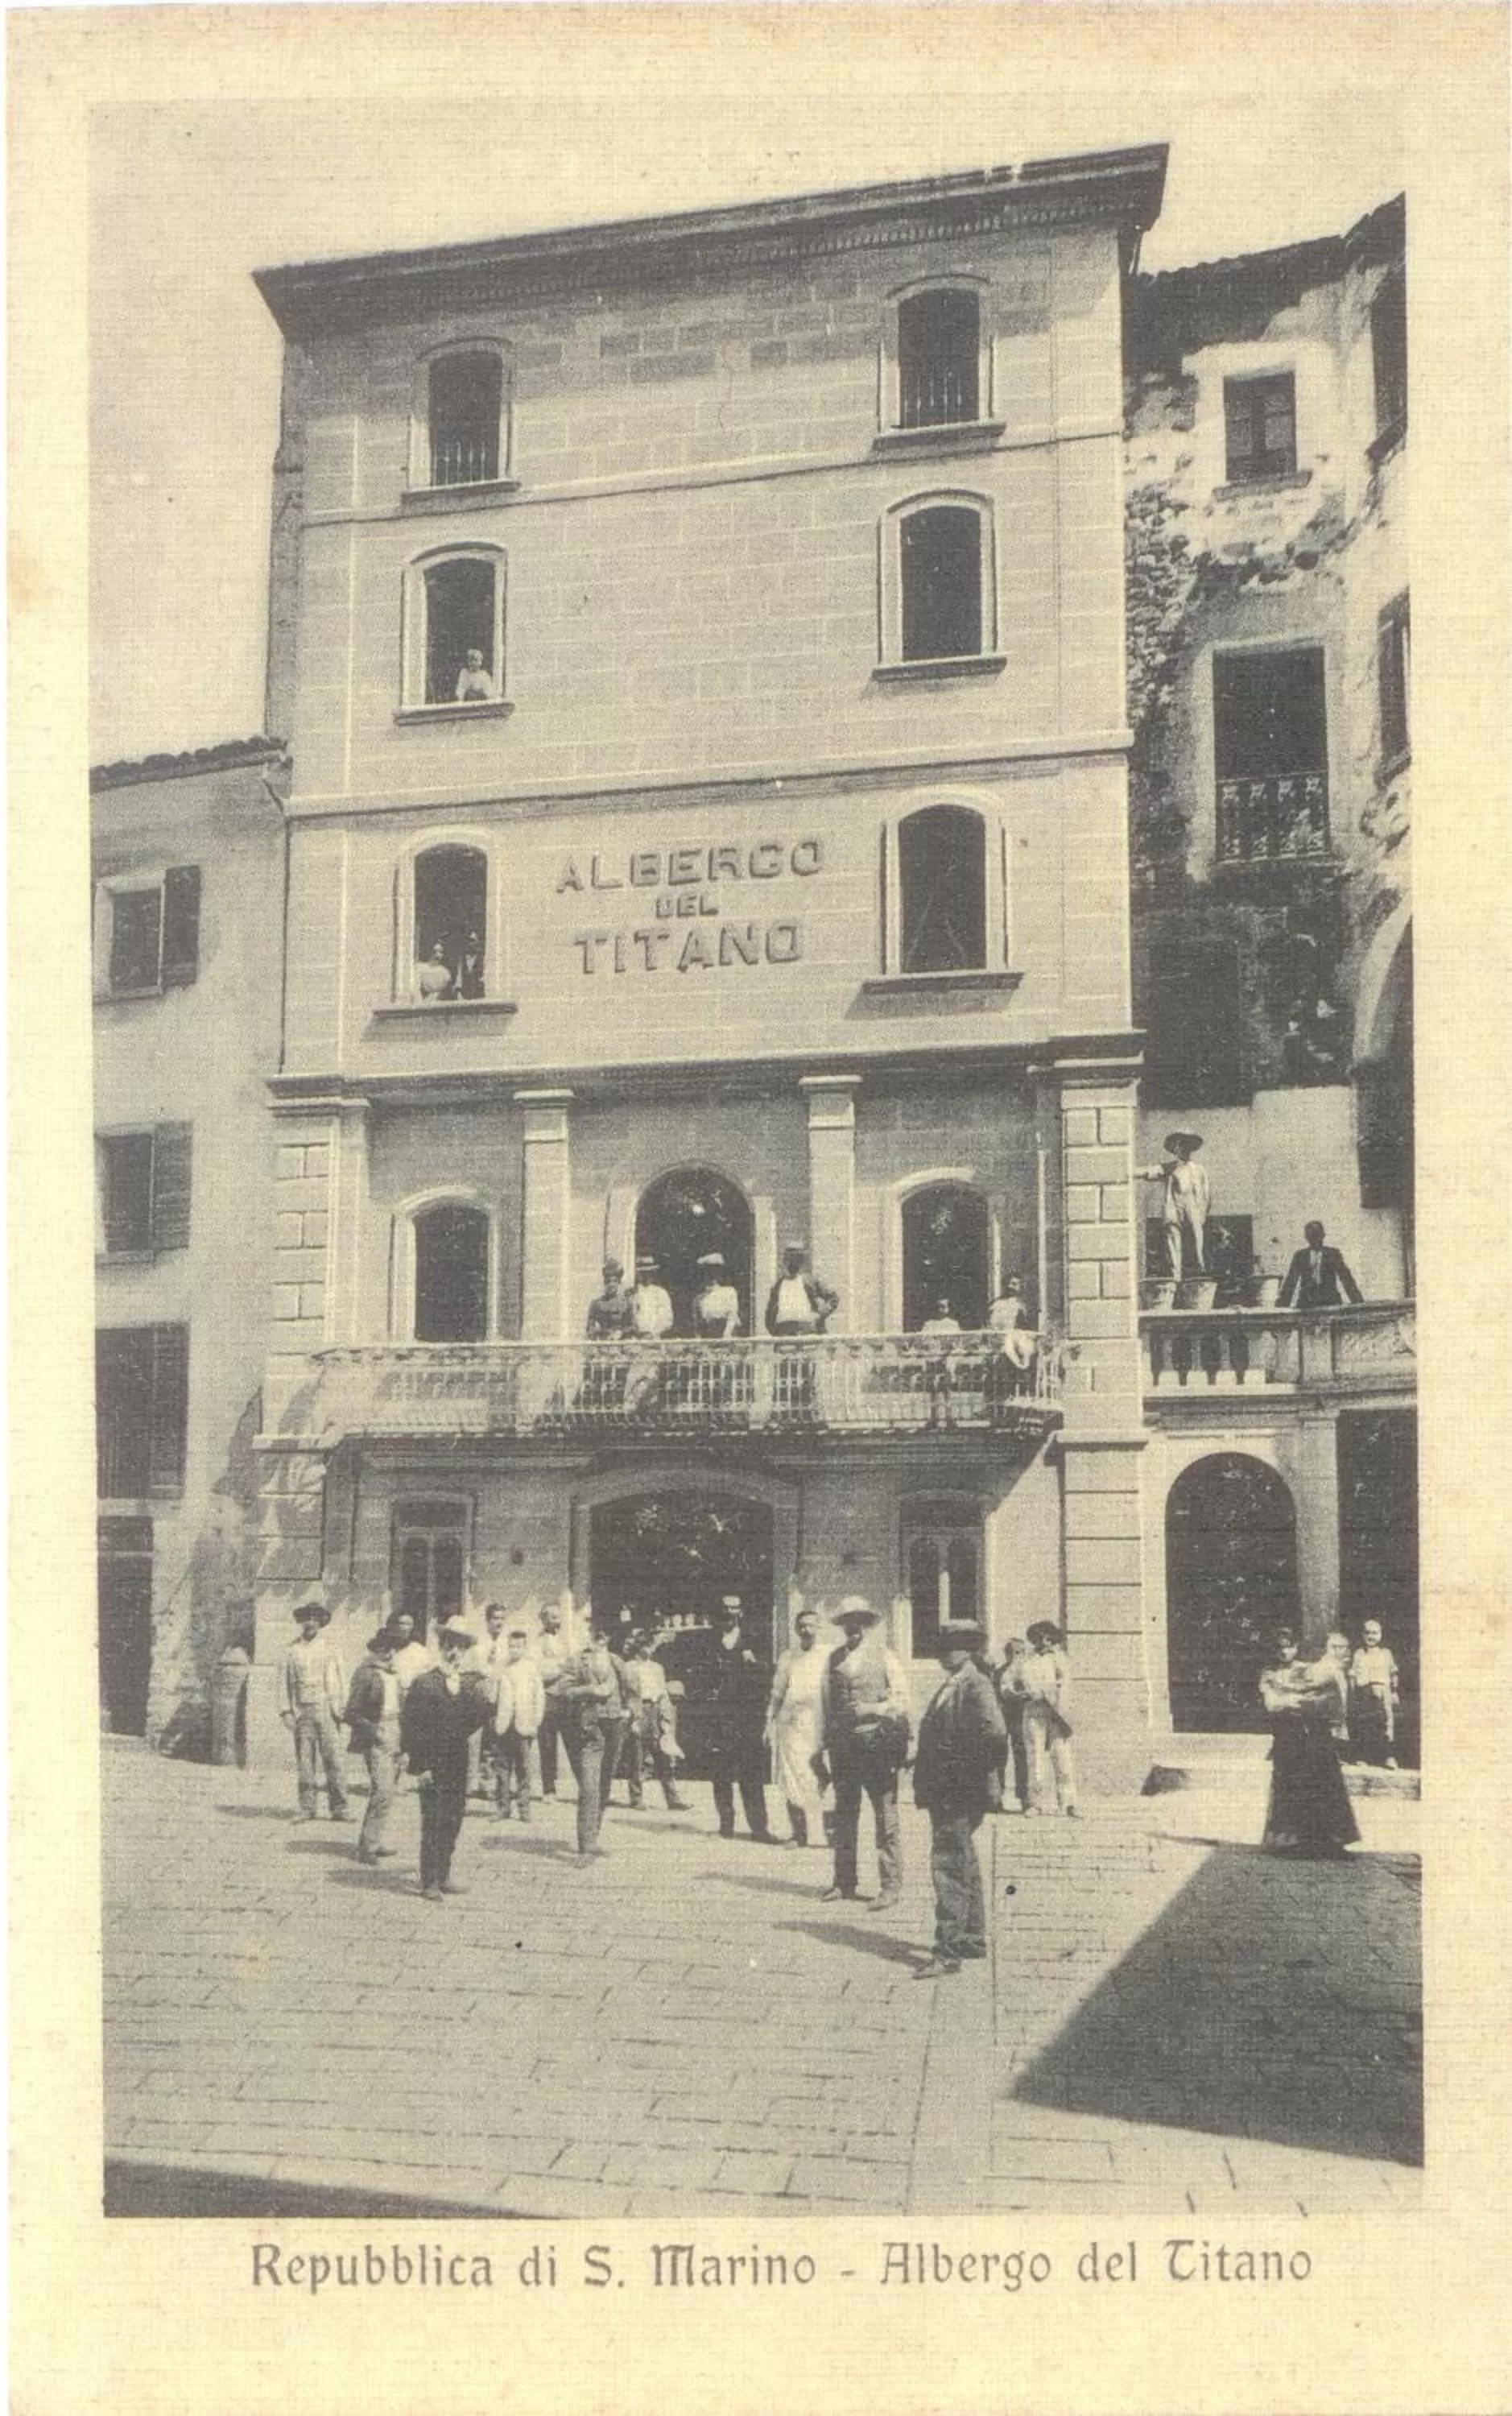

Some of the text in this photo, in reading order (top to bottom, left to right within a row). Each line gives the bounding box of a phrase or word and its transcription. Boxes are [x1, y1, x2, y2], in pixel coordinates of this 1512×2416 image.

[556, 840, 822, 894] ALBERGO
[655, 893, 720, 919] DEL
[572, 924, 804, 974] TITANO
